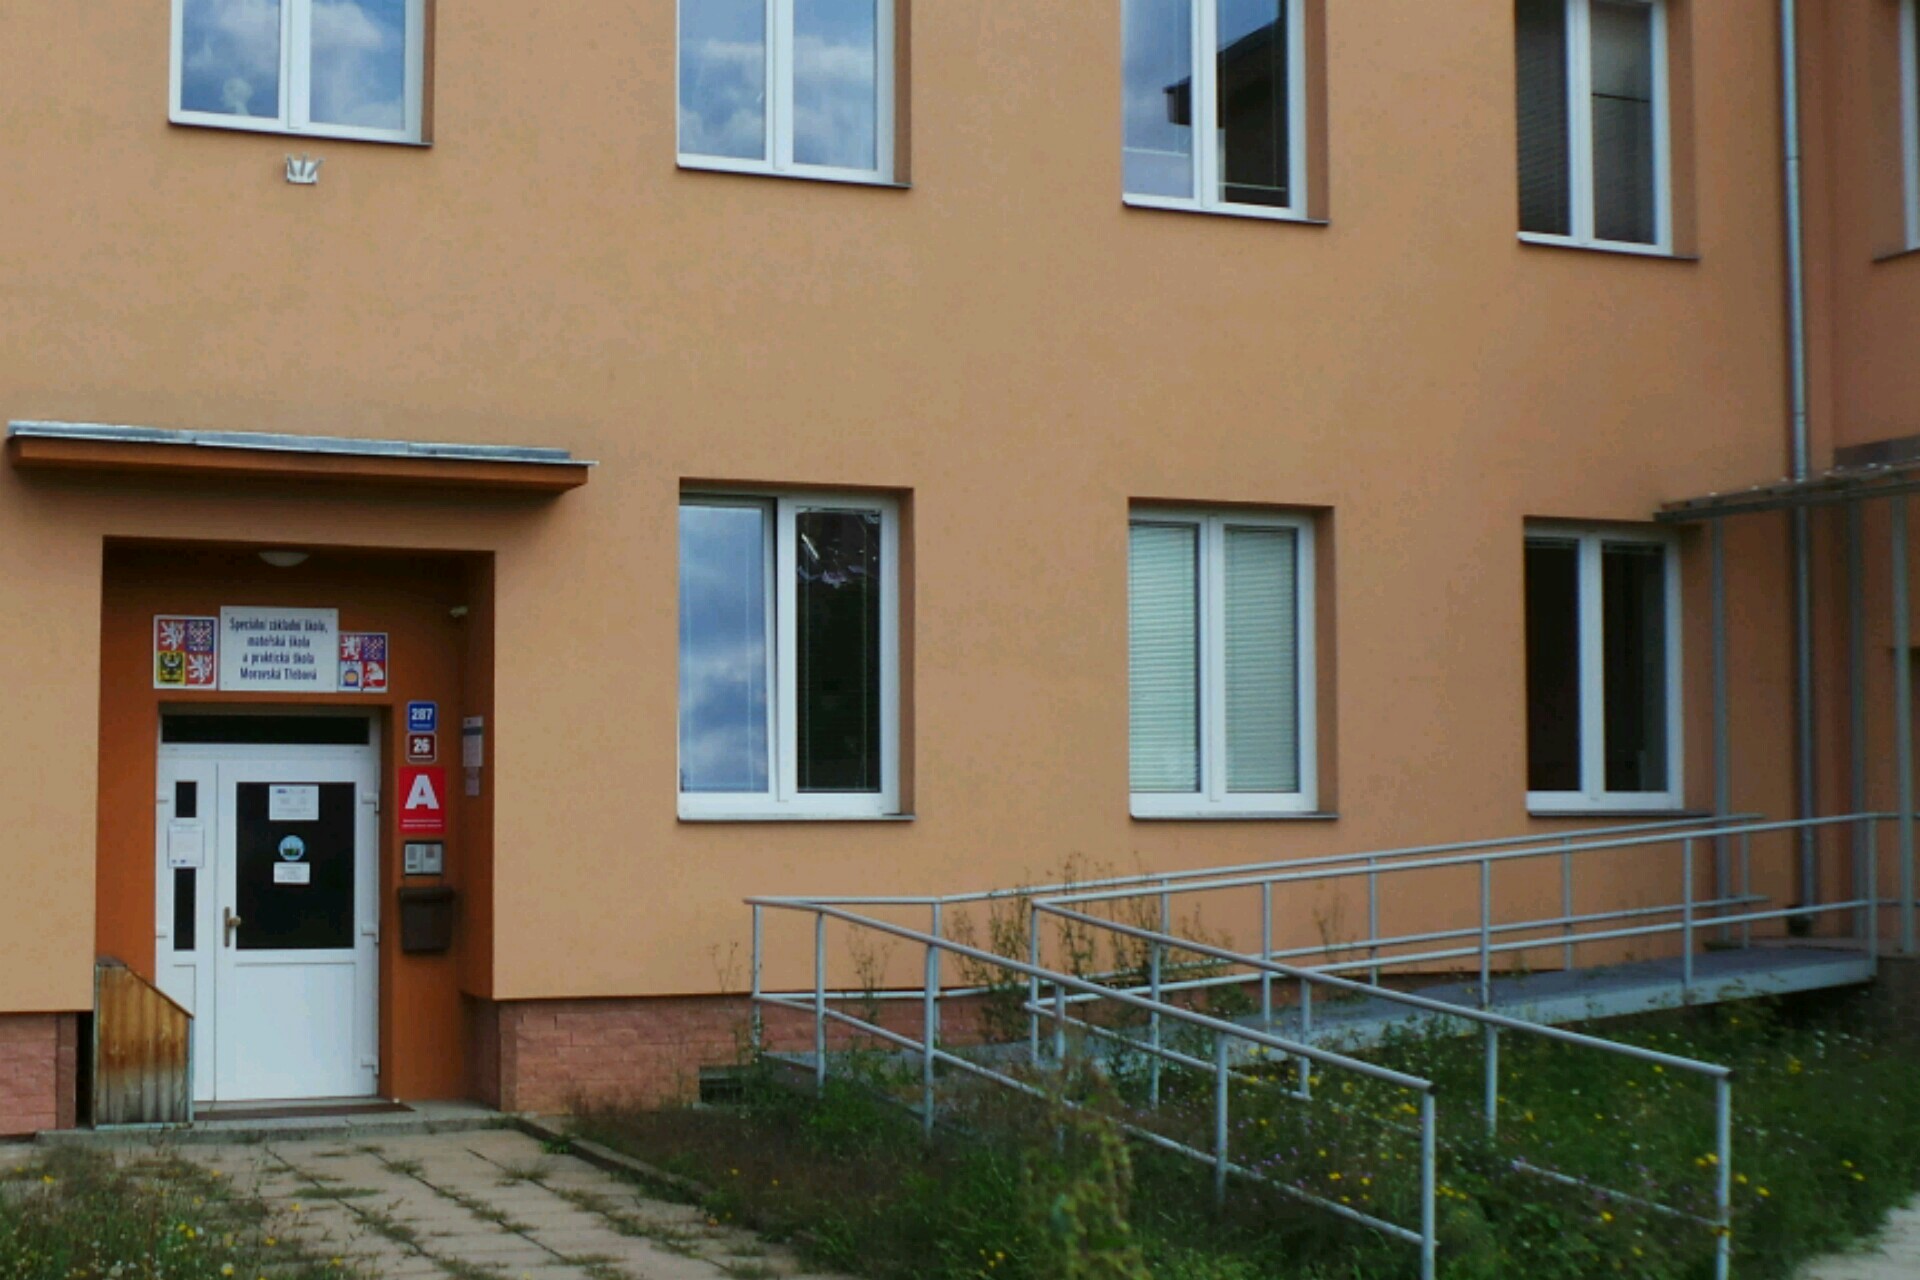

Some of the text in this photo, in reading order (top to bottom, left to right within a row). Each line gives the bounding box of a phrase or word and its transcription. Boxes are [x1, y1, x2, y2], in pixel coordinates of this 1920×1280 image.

[289, 635, 310, 648] škola
[293, 652, 314, 664] škola
[240, 667, 281, 680] Moravská
[413, 738, 430, 753] 26
[405, 774, 439, 810] A
